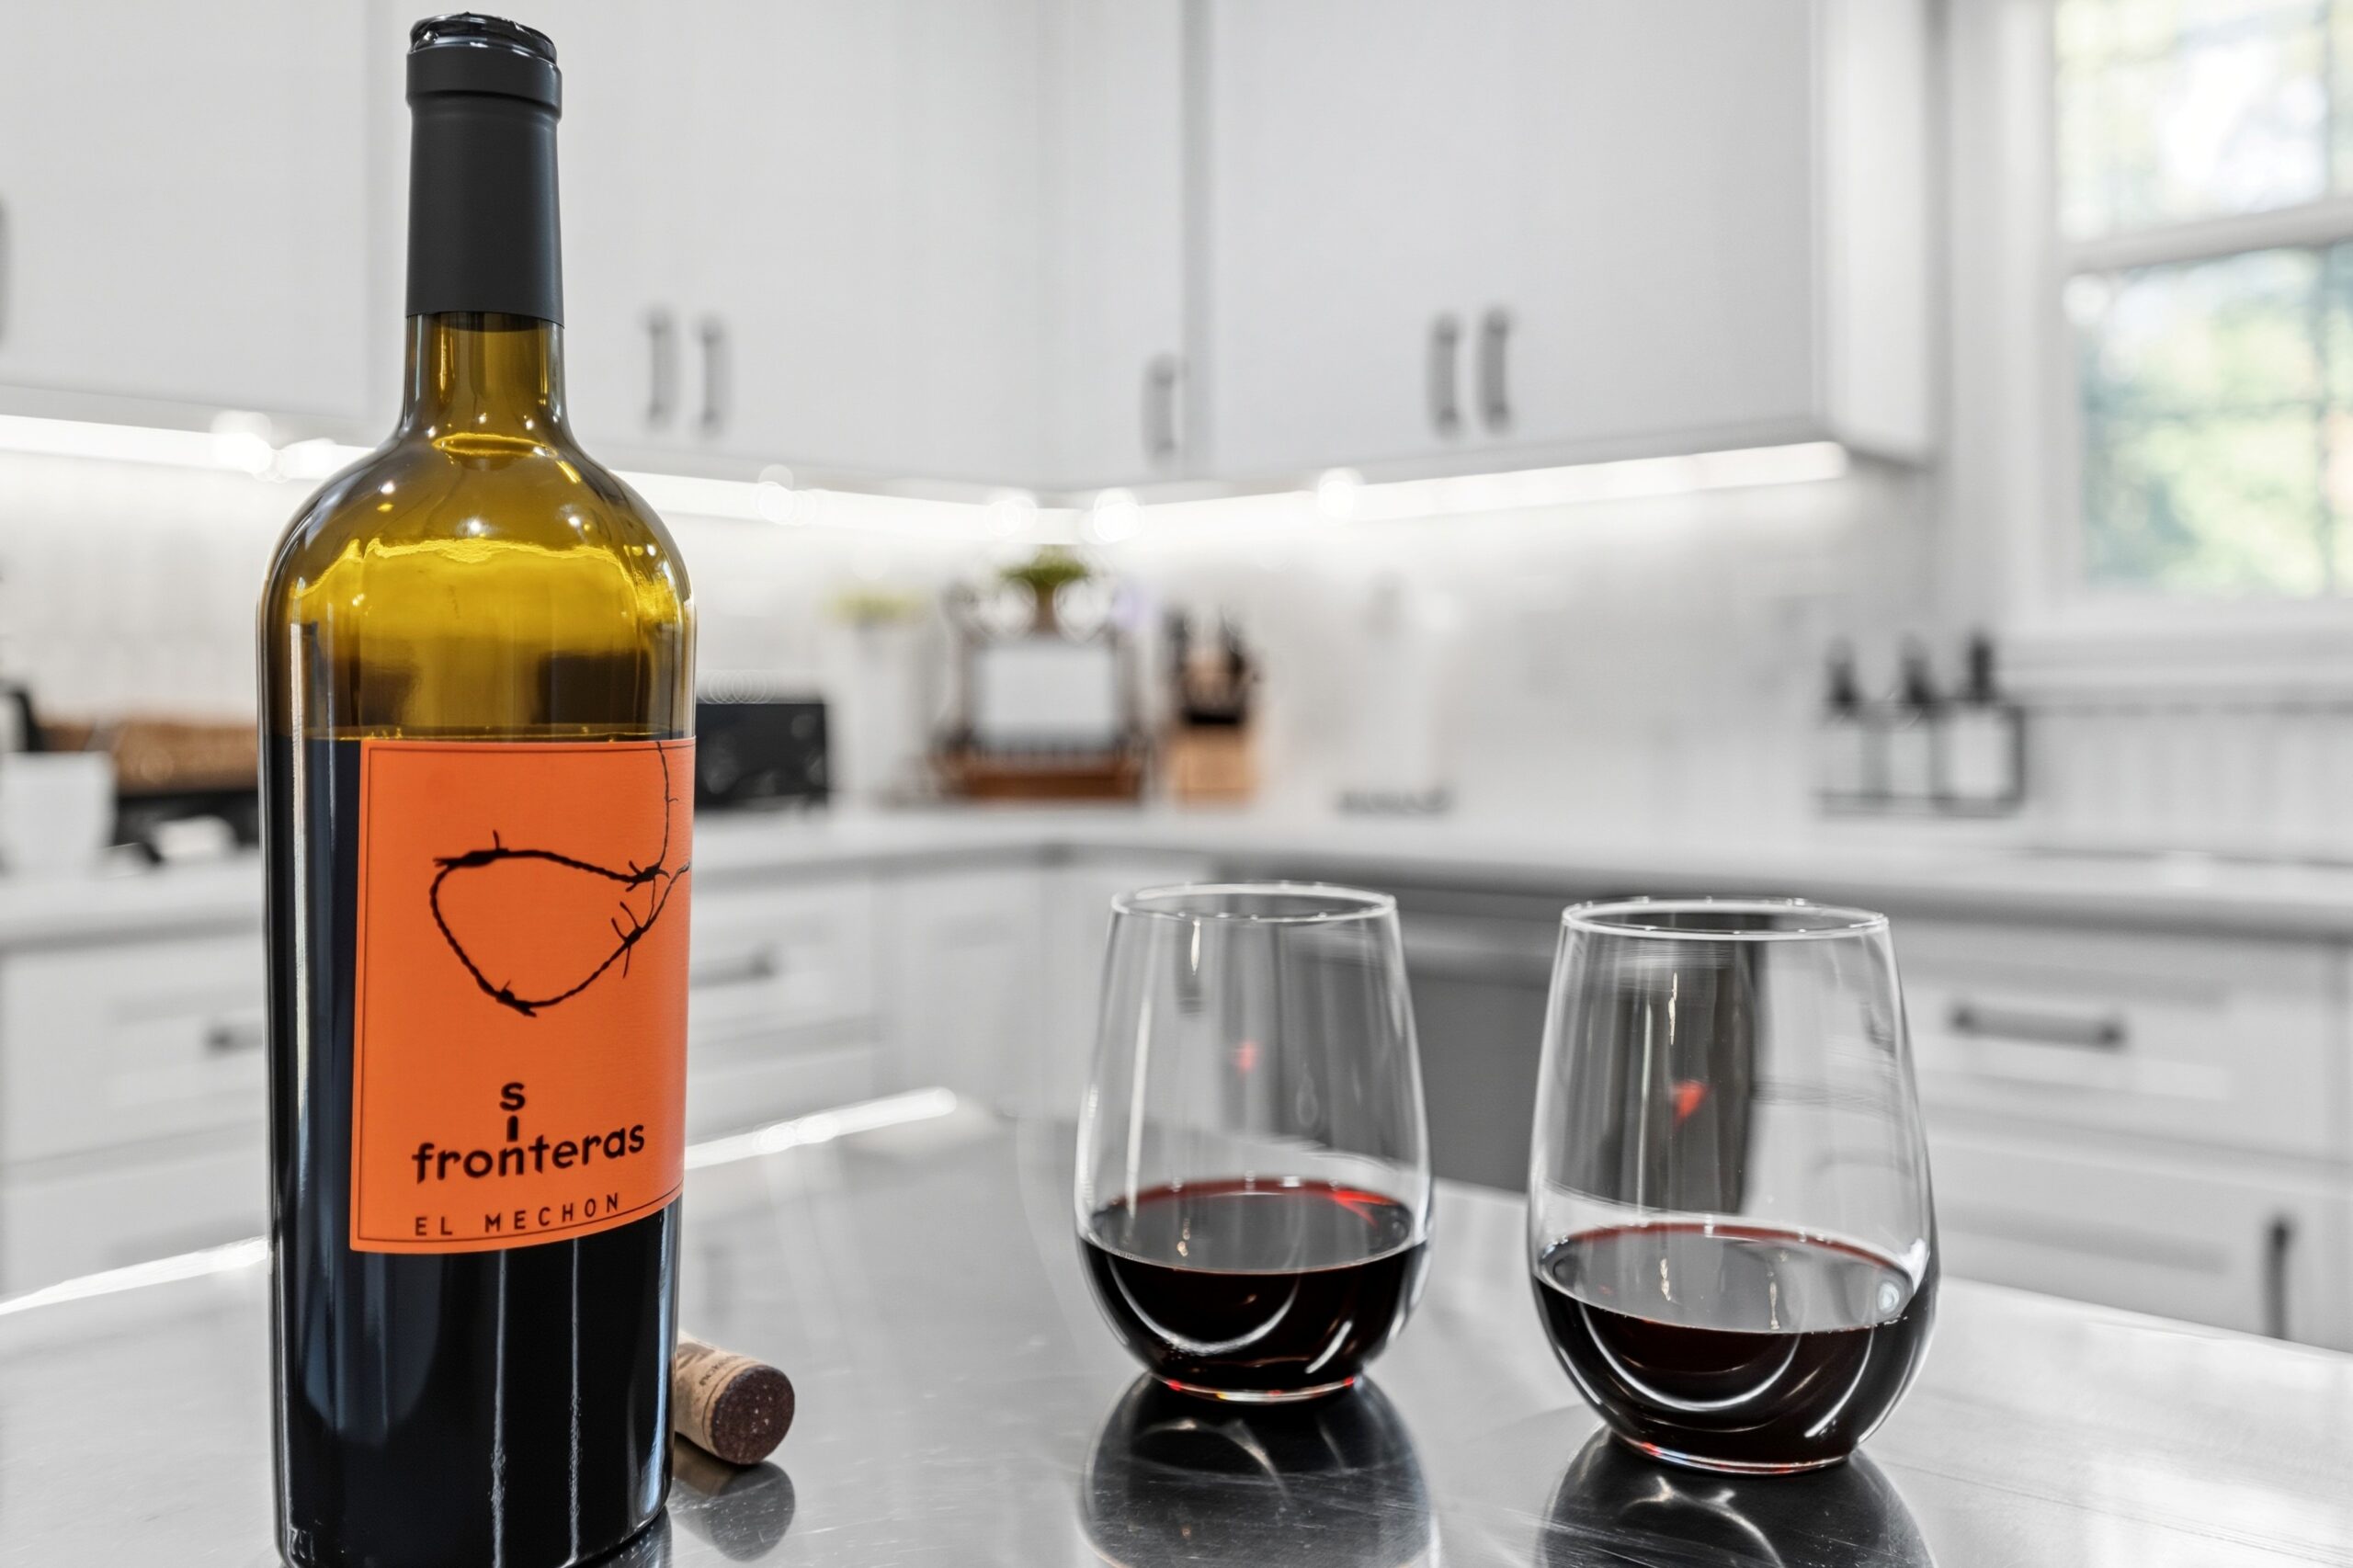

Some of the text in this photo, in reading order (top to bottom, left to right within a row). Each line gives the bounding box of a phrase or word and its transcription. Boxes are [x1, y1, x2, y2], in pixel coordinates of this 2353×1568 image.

[412, 1124, 645, 1183] fronteras
[415, 1192, 619, 1236] EL MECHON
